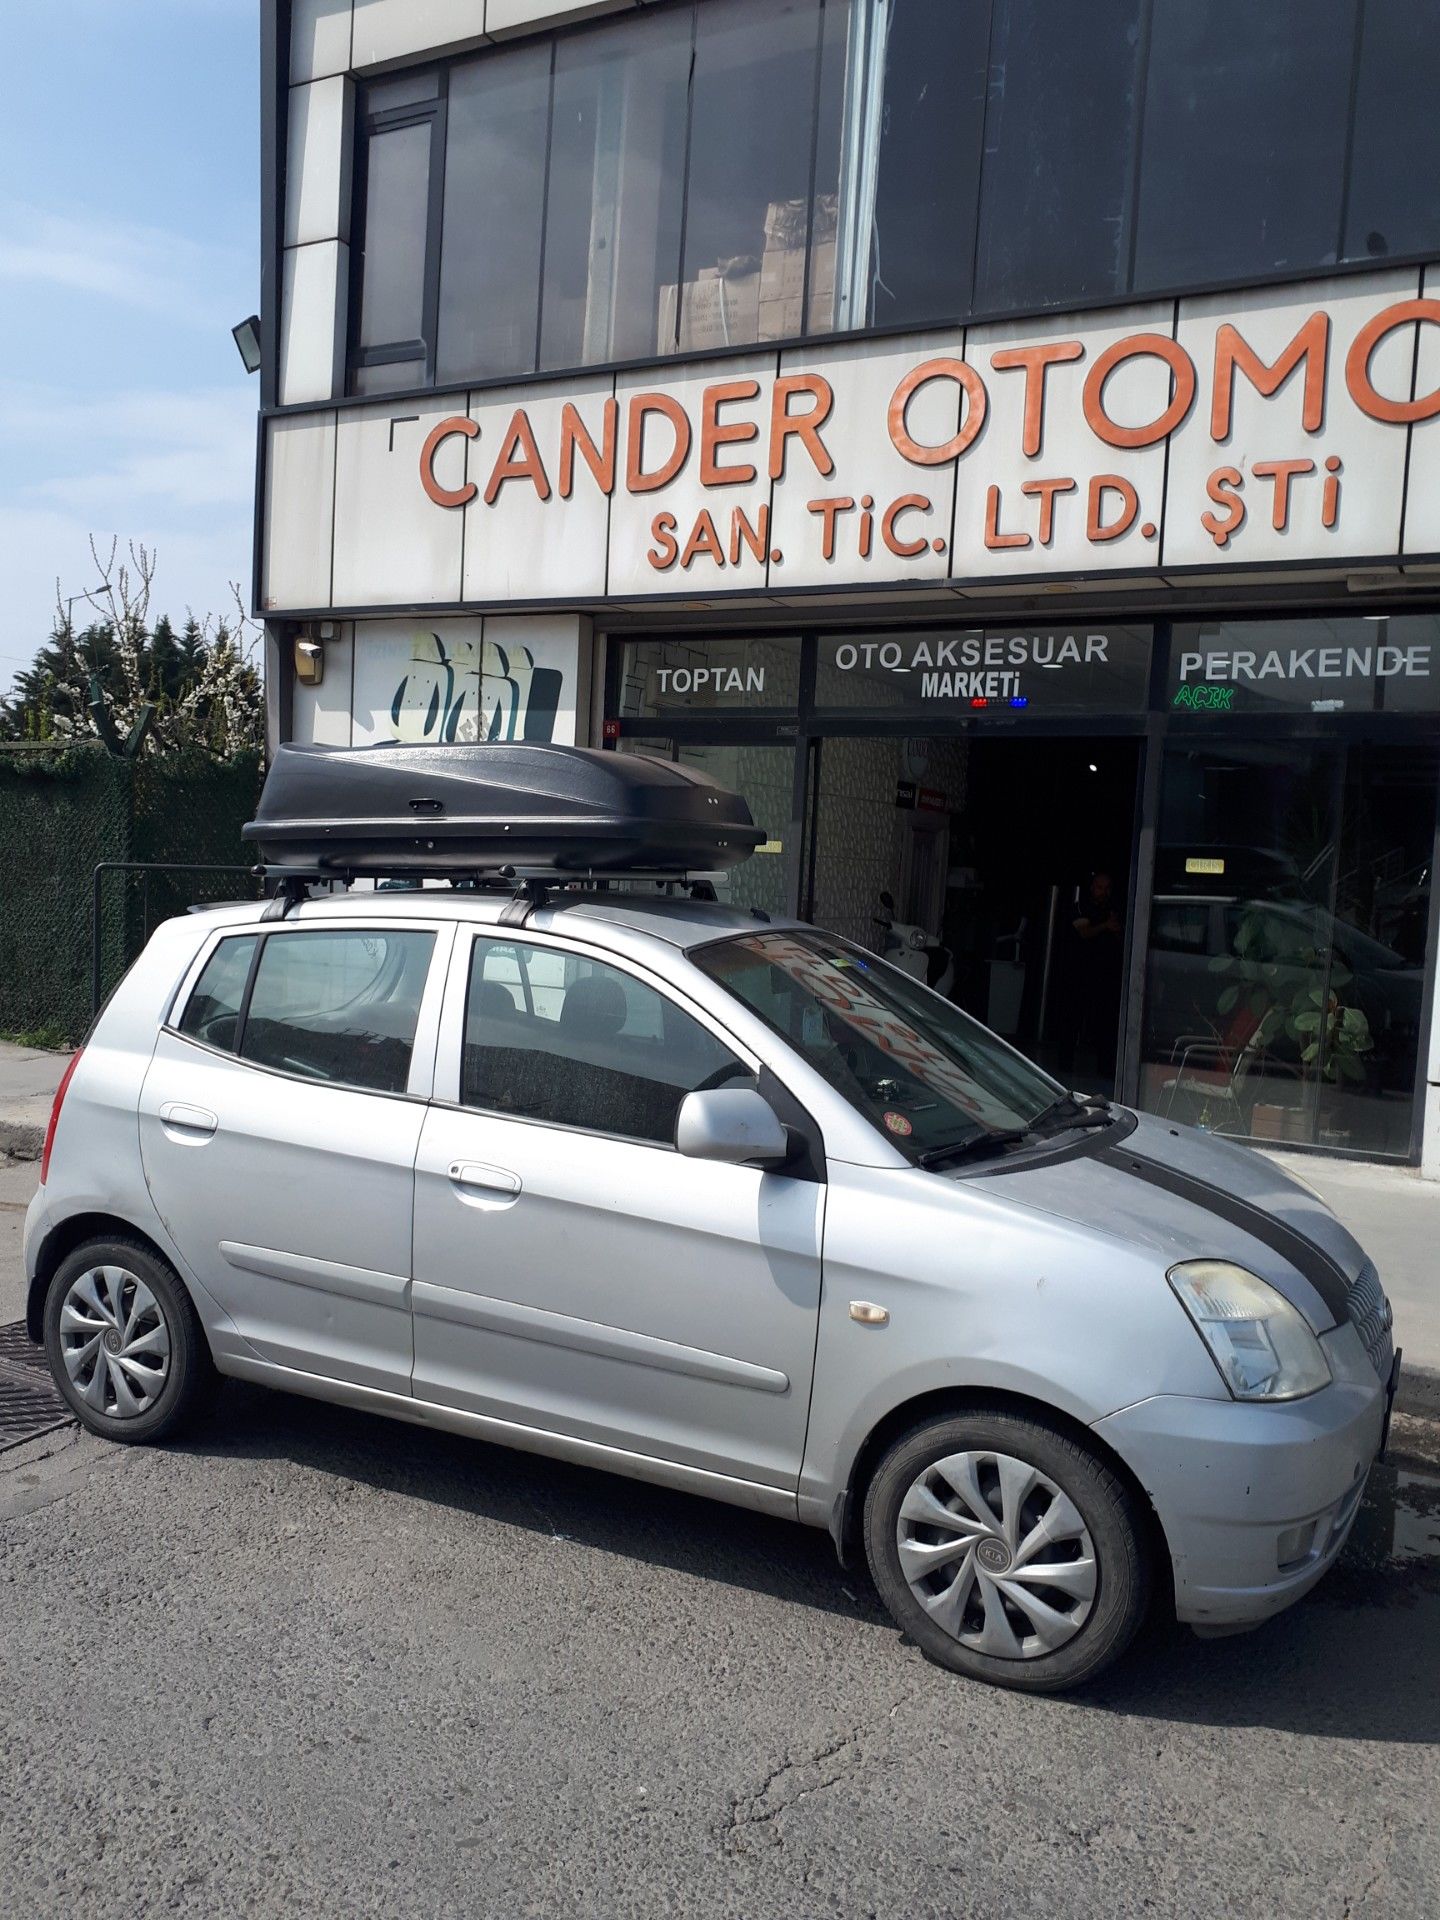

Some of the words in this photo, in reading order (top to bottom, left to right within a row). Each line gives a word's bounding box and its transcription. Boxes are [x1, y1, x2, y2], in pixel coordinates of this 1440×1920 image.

[420, 373, 834, 508] CANDER
[888, 298, 1440, 466] OTOMO
[647, 504, 782, 570] SAN.
[984, 474, 1158, 549] LTD.
[835, 642, 903, 670] OTO
[911, 634, 1110, 668] AKSESUAR
[1180, 646, 1432, 681] PERAKENDE
[656, 666, 766, 692] TOPTAN
[985, 1549, 1002, 1562] KIA
